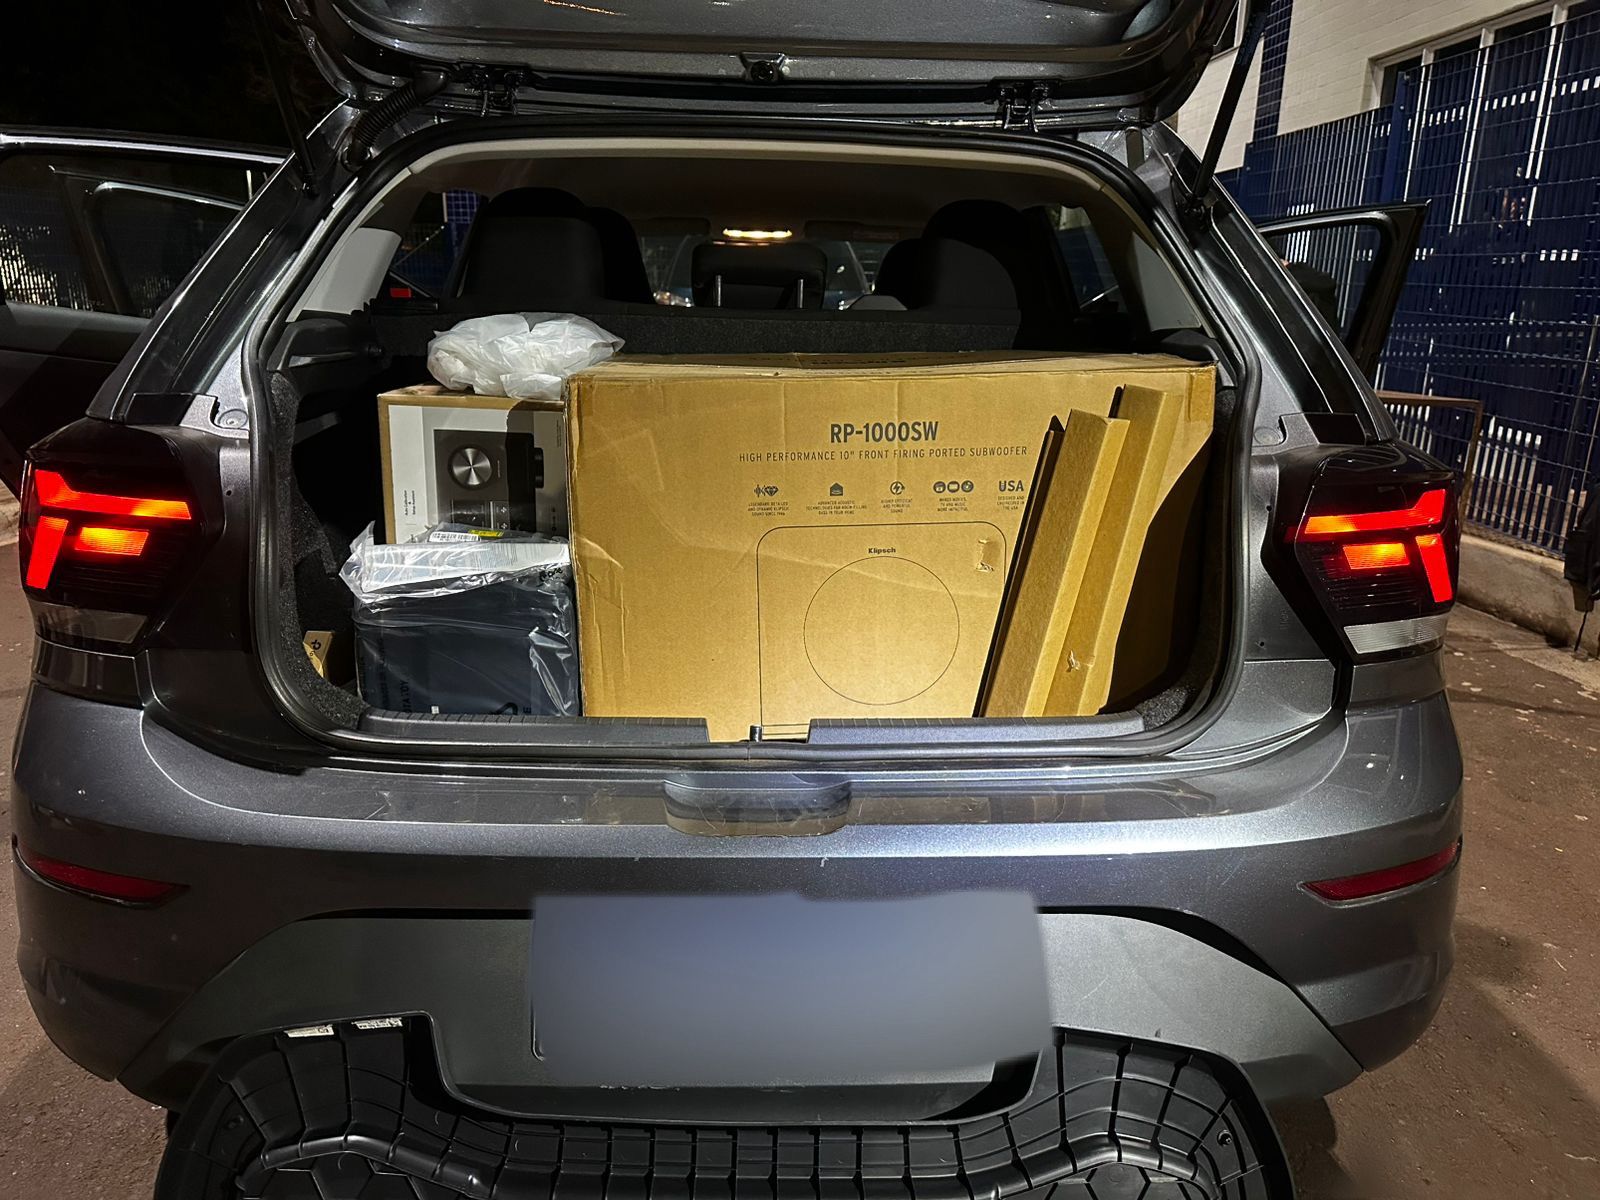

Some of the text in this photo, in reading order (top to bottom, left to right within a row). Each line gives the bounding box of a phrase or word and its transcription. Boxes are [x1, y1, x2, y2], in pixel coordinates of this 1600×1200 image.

[830, 421, 939, 443] RP-1000SW
[739, 446, 1027, 462] HIGH PERFORMANCE 10" FRONT FIRING PORTED SUBWOOFER
[998, 480, 1024, 492] USA
[868, 547, 896, 556] Klipsch
